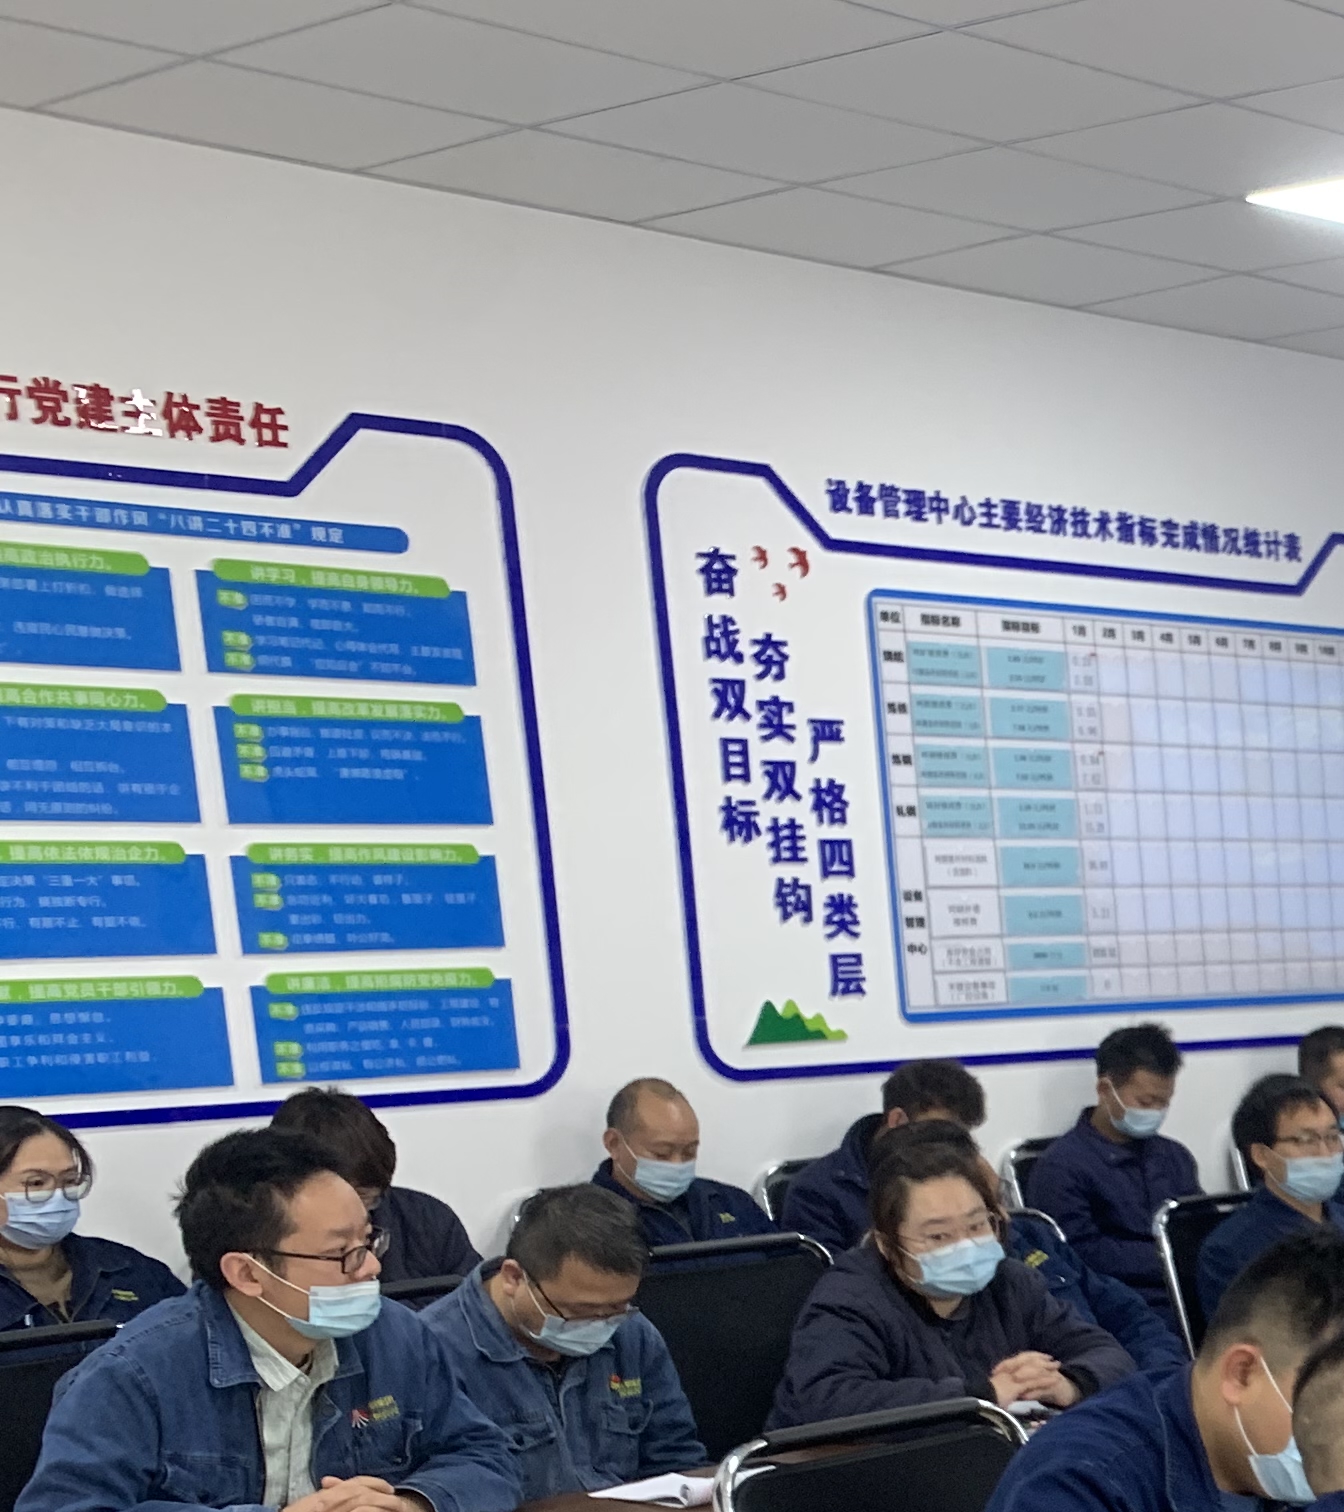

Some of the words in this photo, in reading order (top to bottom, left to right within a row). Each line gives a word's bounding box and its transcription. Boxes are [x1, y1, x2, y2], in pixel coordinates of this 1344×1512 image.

[0, 548, 111, 570] 高政治执行力。
[825, 478, 1303, 564] 设备管理中心主要经济技术指标完成情况统计表
[0, 688, 147, 709] 高合作共事同心力。
[695, 546, 762, 846] 奋战双目标
[750, 632, 814, 925] 夯实双挂钩
[807, 718, 867, 999] 严格四类层
